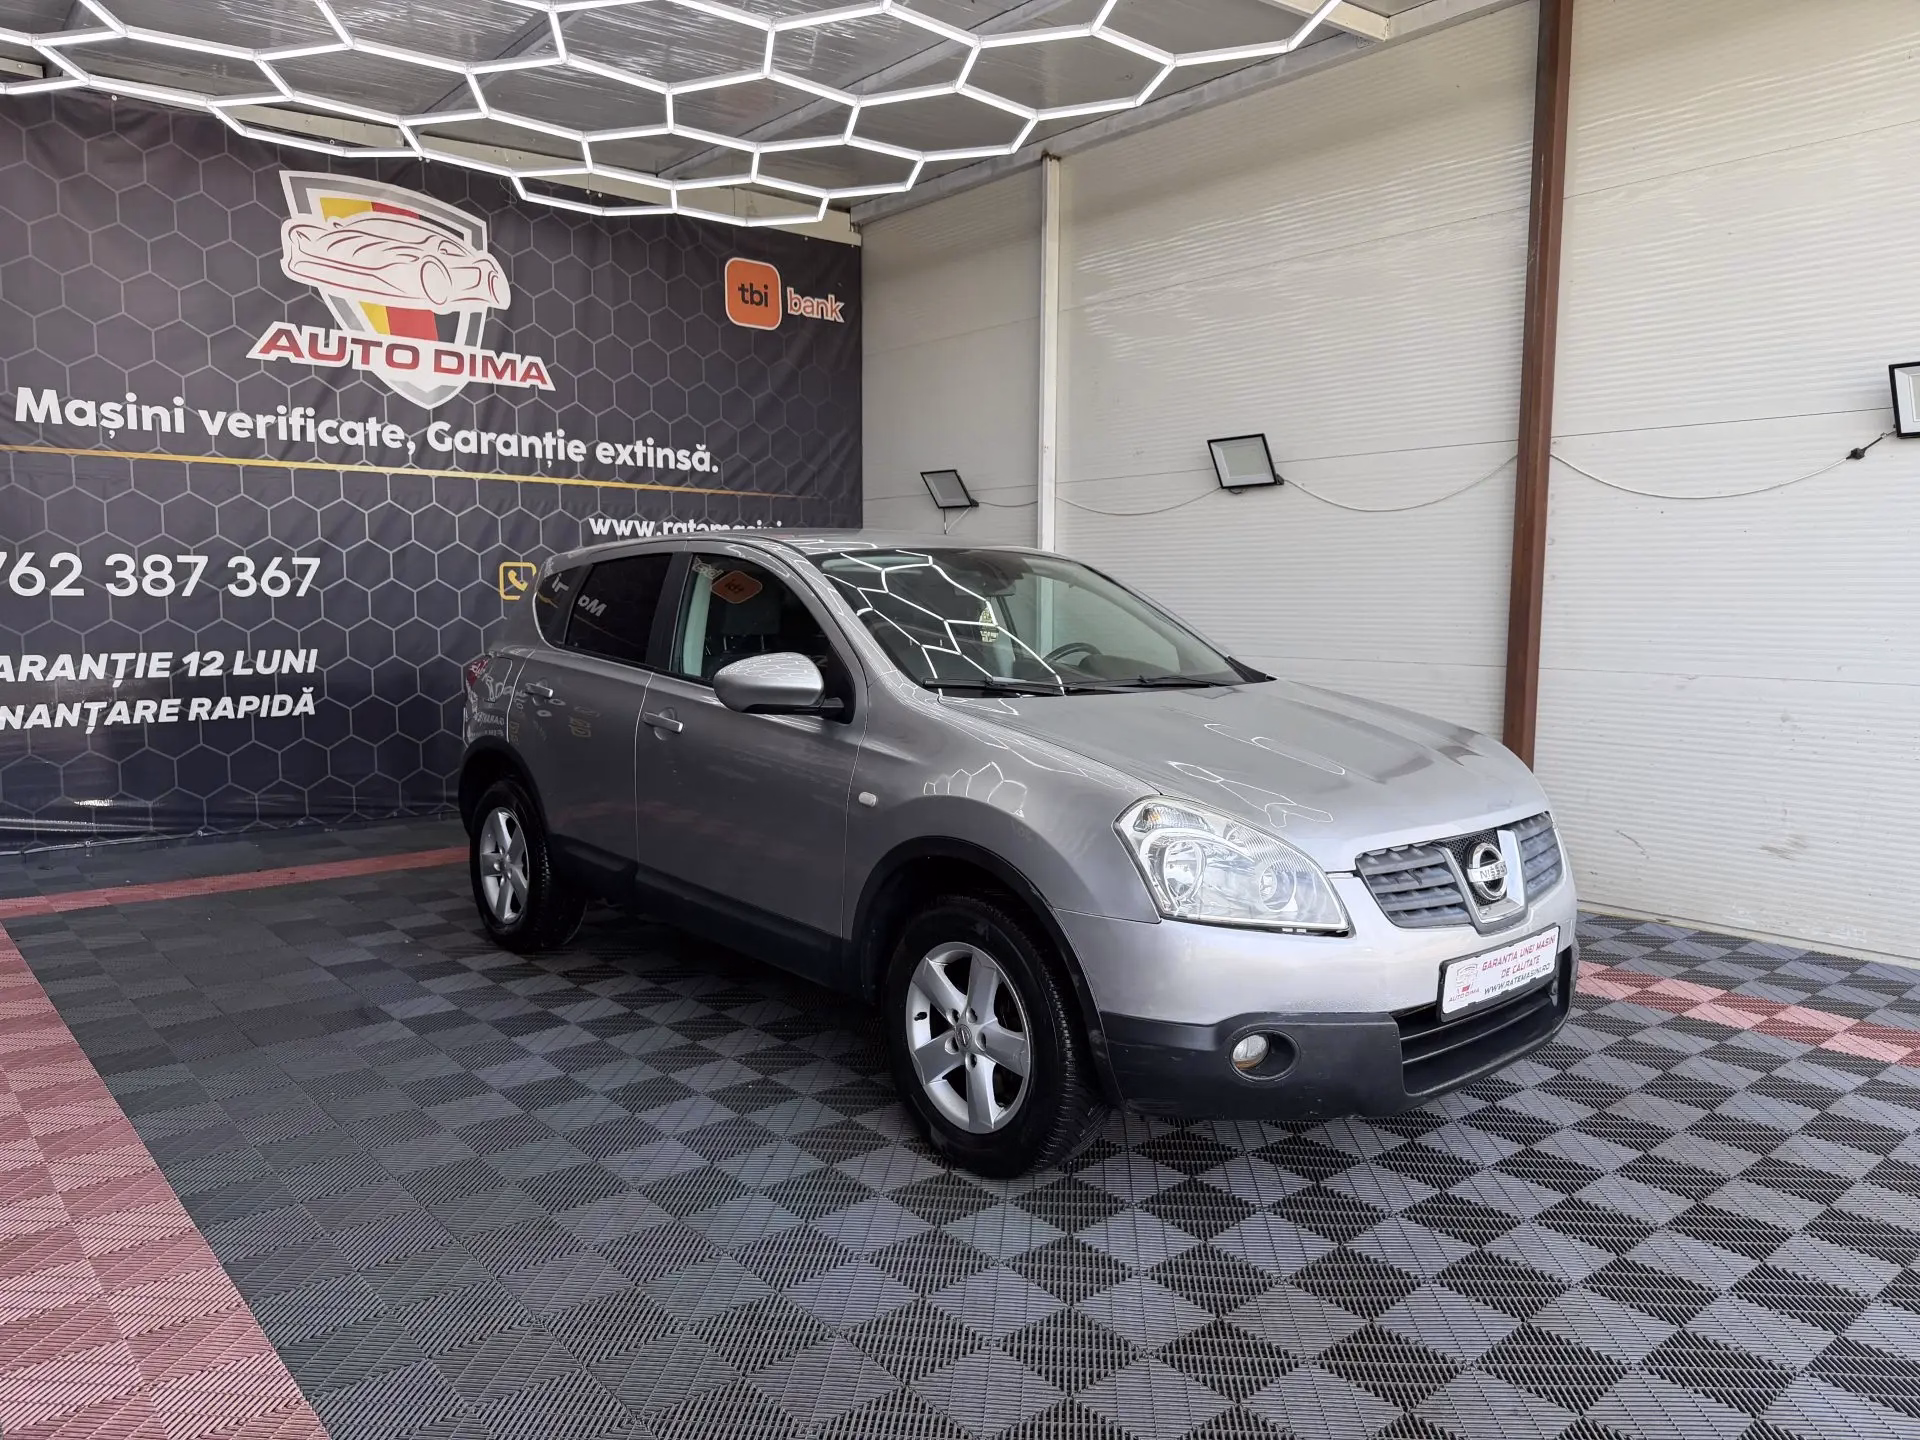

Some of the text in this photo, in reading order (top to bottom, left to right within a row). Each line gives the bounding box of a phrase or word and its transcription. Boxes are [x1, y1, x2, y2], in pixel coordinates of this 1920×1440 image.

[738, 282, 845, 323] tbi bank
[258, 328, 550, 385] AUTO DIMA
[15, 386, 719, 473] Mașini verificate, Garanție extinsă.
[0, 552, 321, 597] 62 387 367
[181, 650, 225, 677] 12
[232, 648, 318, 675] LUNI
[188, 686, 316, 721] RAPIDĂ
[1480, 862, 1507, 879] NISSAN
[1482, 951, 1518, 971] GARANTIA
[1535, 934, 1556, 951] MASINI
[1500, 954, 1541, 978] DE CALITATE
[1449, 987, 1480, 1002] AUTO DIMA
